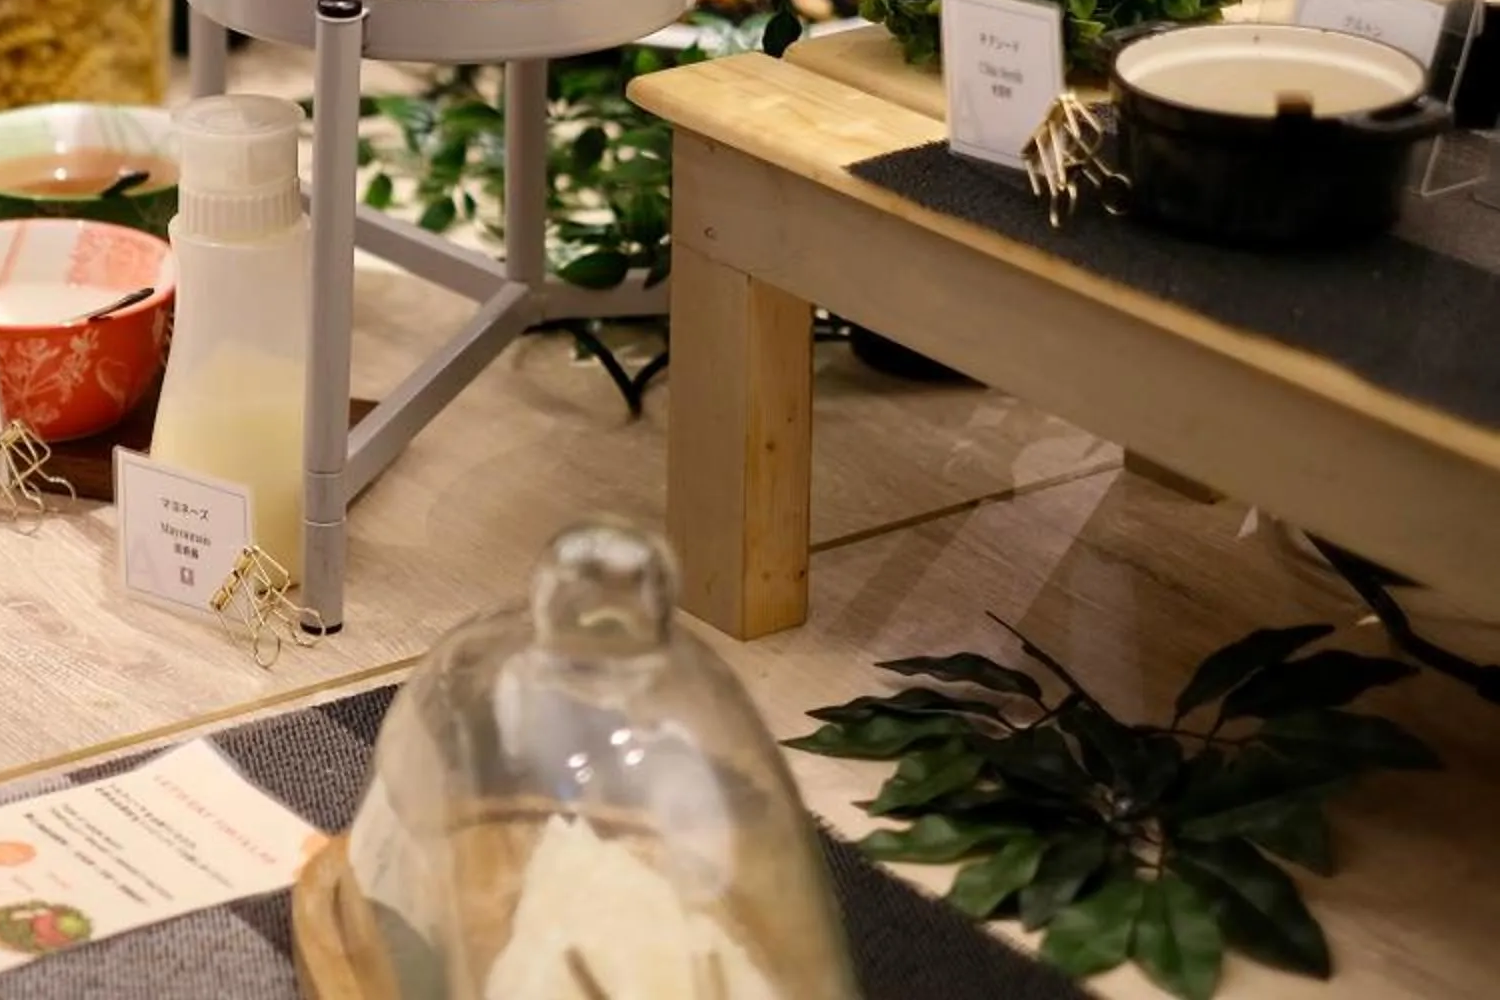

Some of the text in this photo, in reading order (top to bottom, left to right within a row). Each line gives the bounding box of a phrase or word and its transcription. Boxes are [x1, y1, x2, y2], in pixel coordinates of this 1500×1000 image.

[159, 497, 210, 522] マヨネーズ
